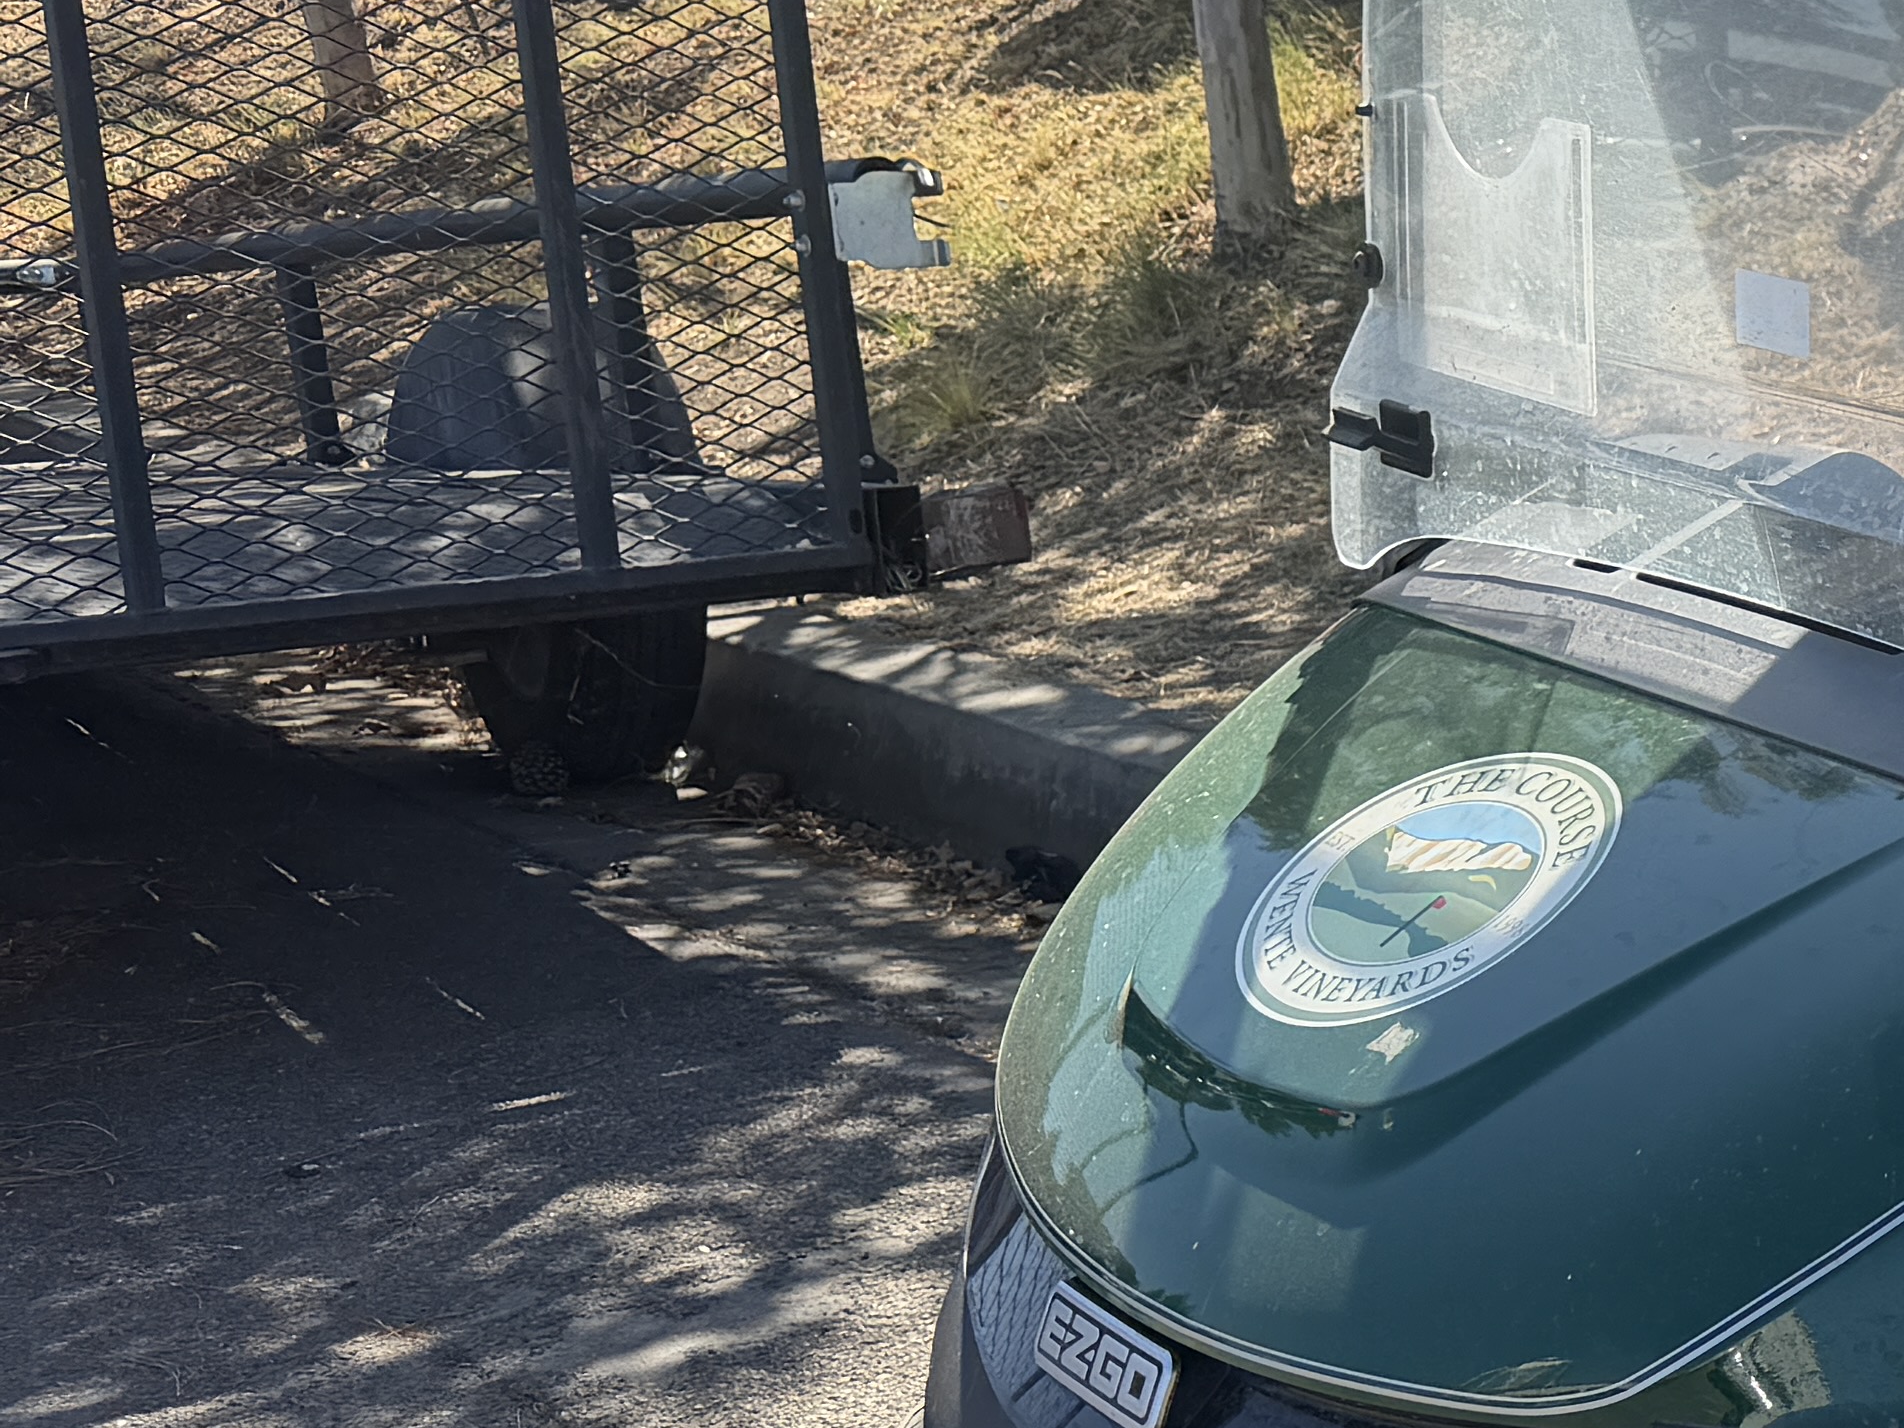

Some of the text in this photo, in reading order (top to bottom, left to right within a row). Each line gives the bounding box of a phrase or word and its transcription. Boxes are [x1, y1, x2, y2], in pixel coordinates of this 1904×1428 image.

[1414, 767, 1597, 870] THE COURSE
[1263, 869, 1475, 1003] WENTE VINEYARDS
